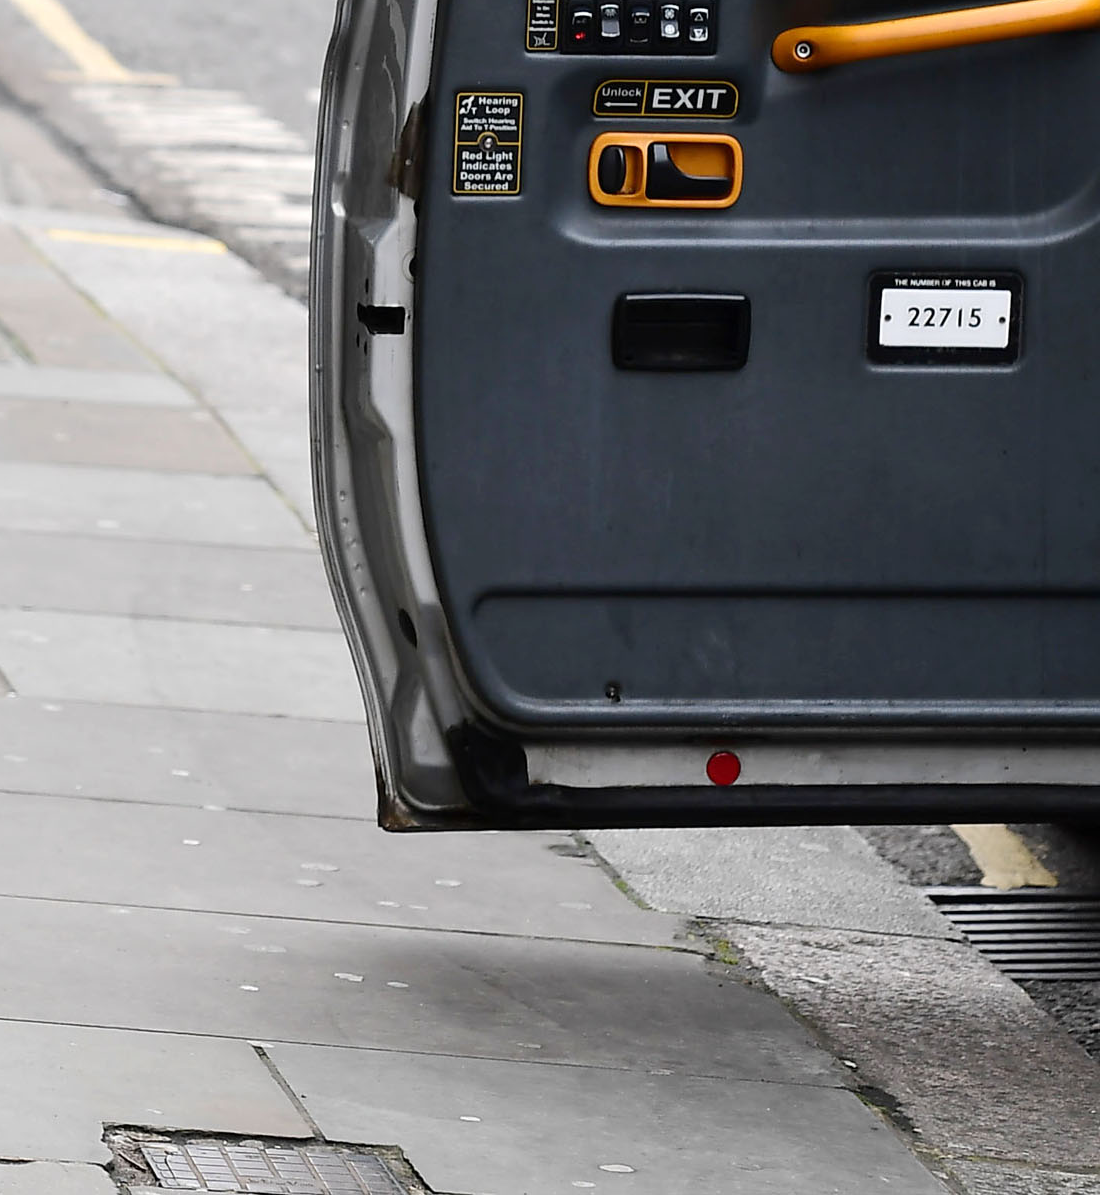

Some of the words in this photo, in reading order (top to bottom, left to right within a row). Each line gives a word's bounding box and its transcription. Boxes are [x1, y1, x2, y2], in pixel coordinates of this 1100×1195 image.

[602, 87, 642, 98] Unlock
[478, 97, 518, 107] Hearing
[652, 88, 727, 109] EXIT
[485, 106, 510, 116] Loop
[488, 117, 516, 125] Hearing
[462, 151, 482, 160] Red
[485, 151, 513, 162] Light
[462, 161, 512, 171] Indicates
[460, 172, 491, 181] Doors
[494, 172, 514, 181] Are
[464, 181, 509, 190] Secured
[910, 279, 940, 287] NUMBER
[942, 279, 952, 287] OF
[955, 279, 971, 287] THIS
[972, 279, 988, 287] CAB
[989, 279, 997, 287] IS
[908, 307, 982, 328] 22715
